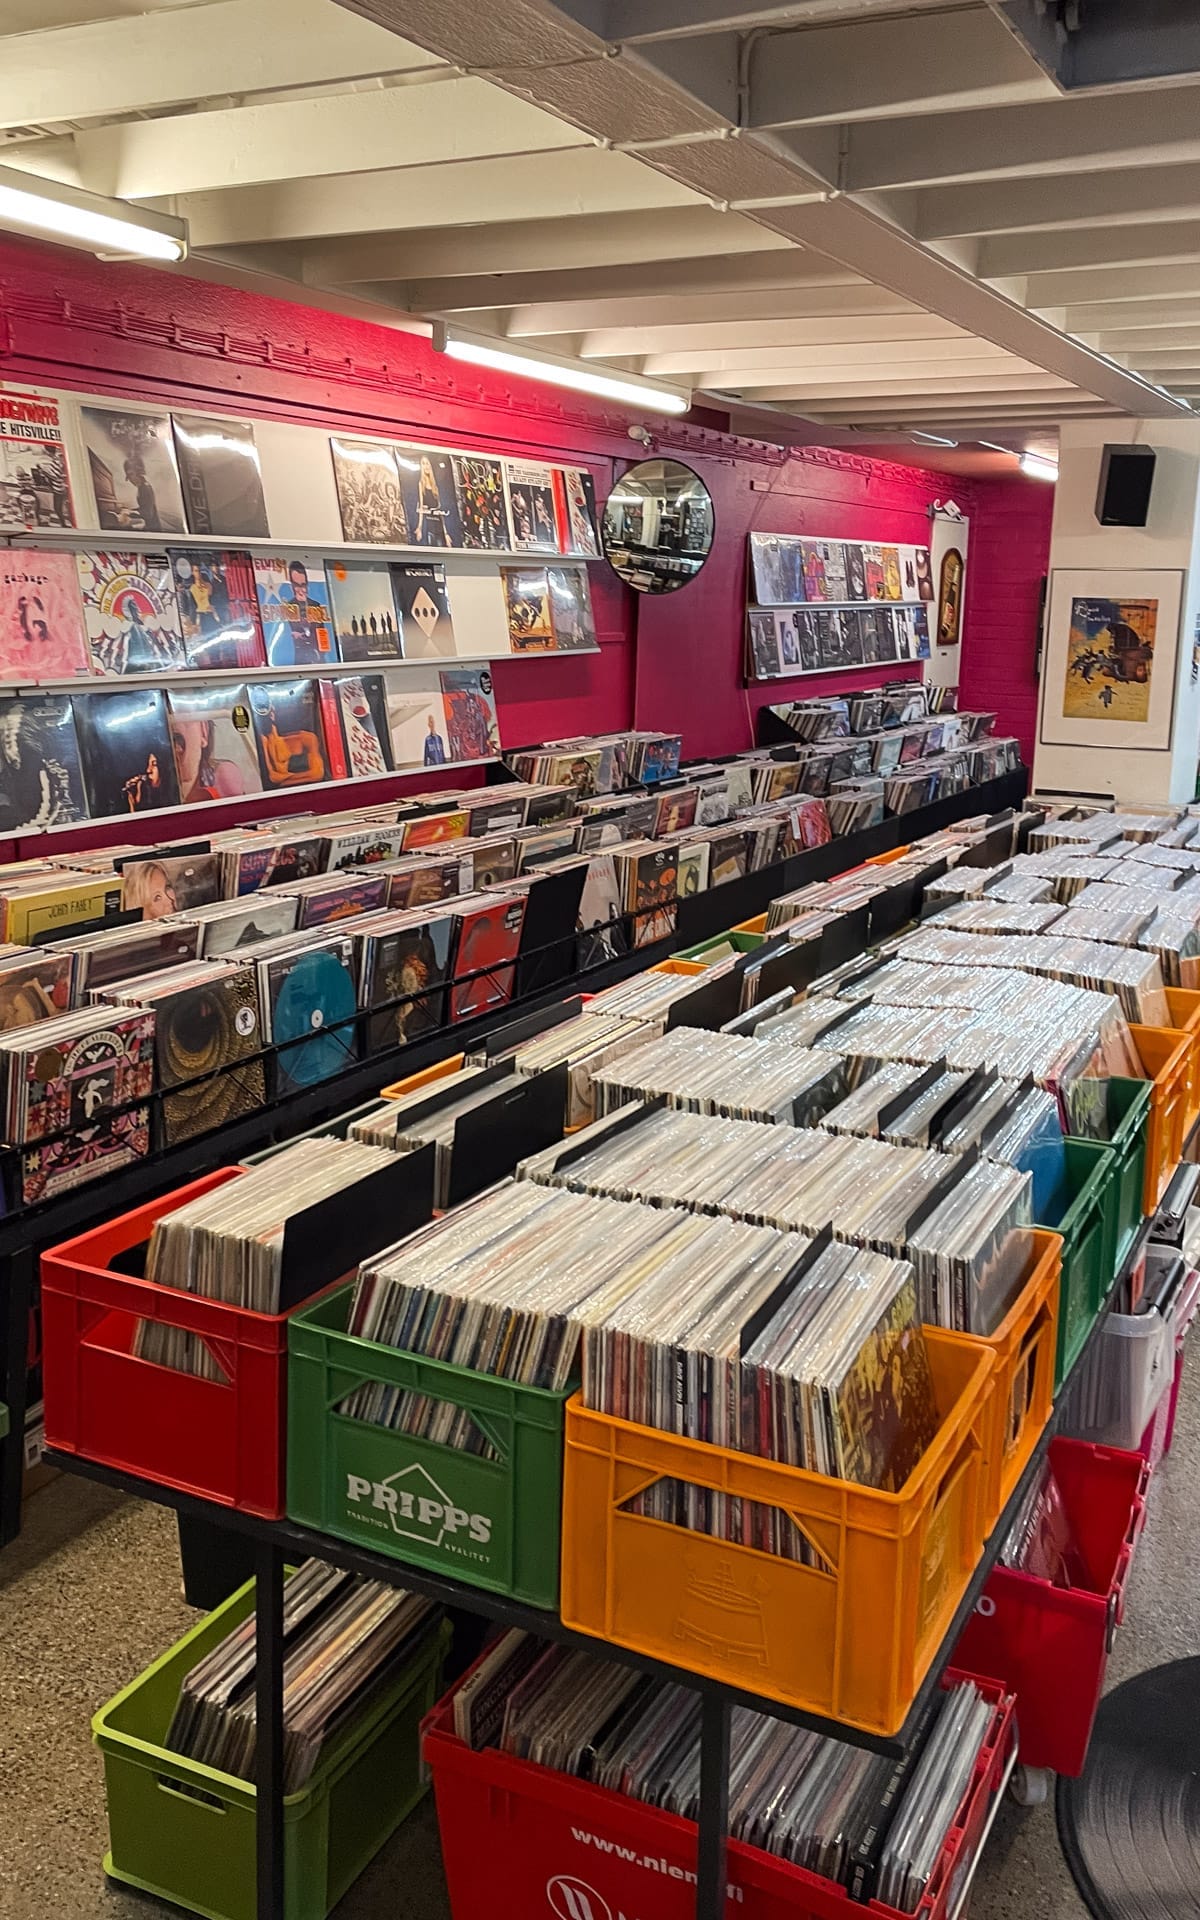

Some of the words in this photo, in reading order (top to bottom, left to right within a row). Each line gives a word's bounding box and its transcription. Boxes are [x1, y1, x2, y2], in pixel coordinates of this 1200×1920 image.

[346, 1473, 492, 1544] PRIPPS
[346, 1510, 389, 1530] TRADITION
[444, 1543, 491, 1564] KVALITET
